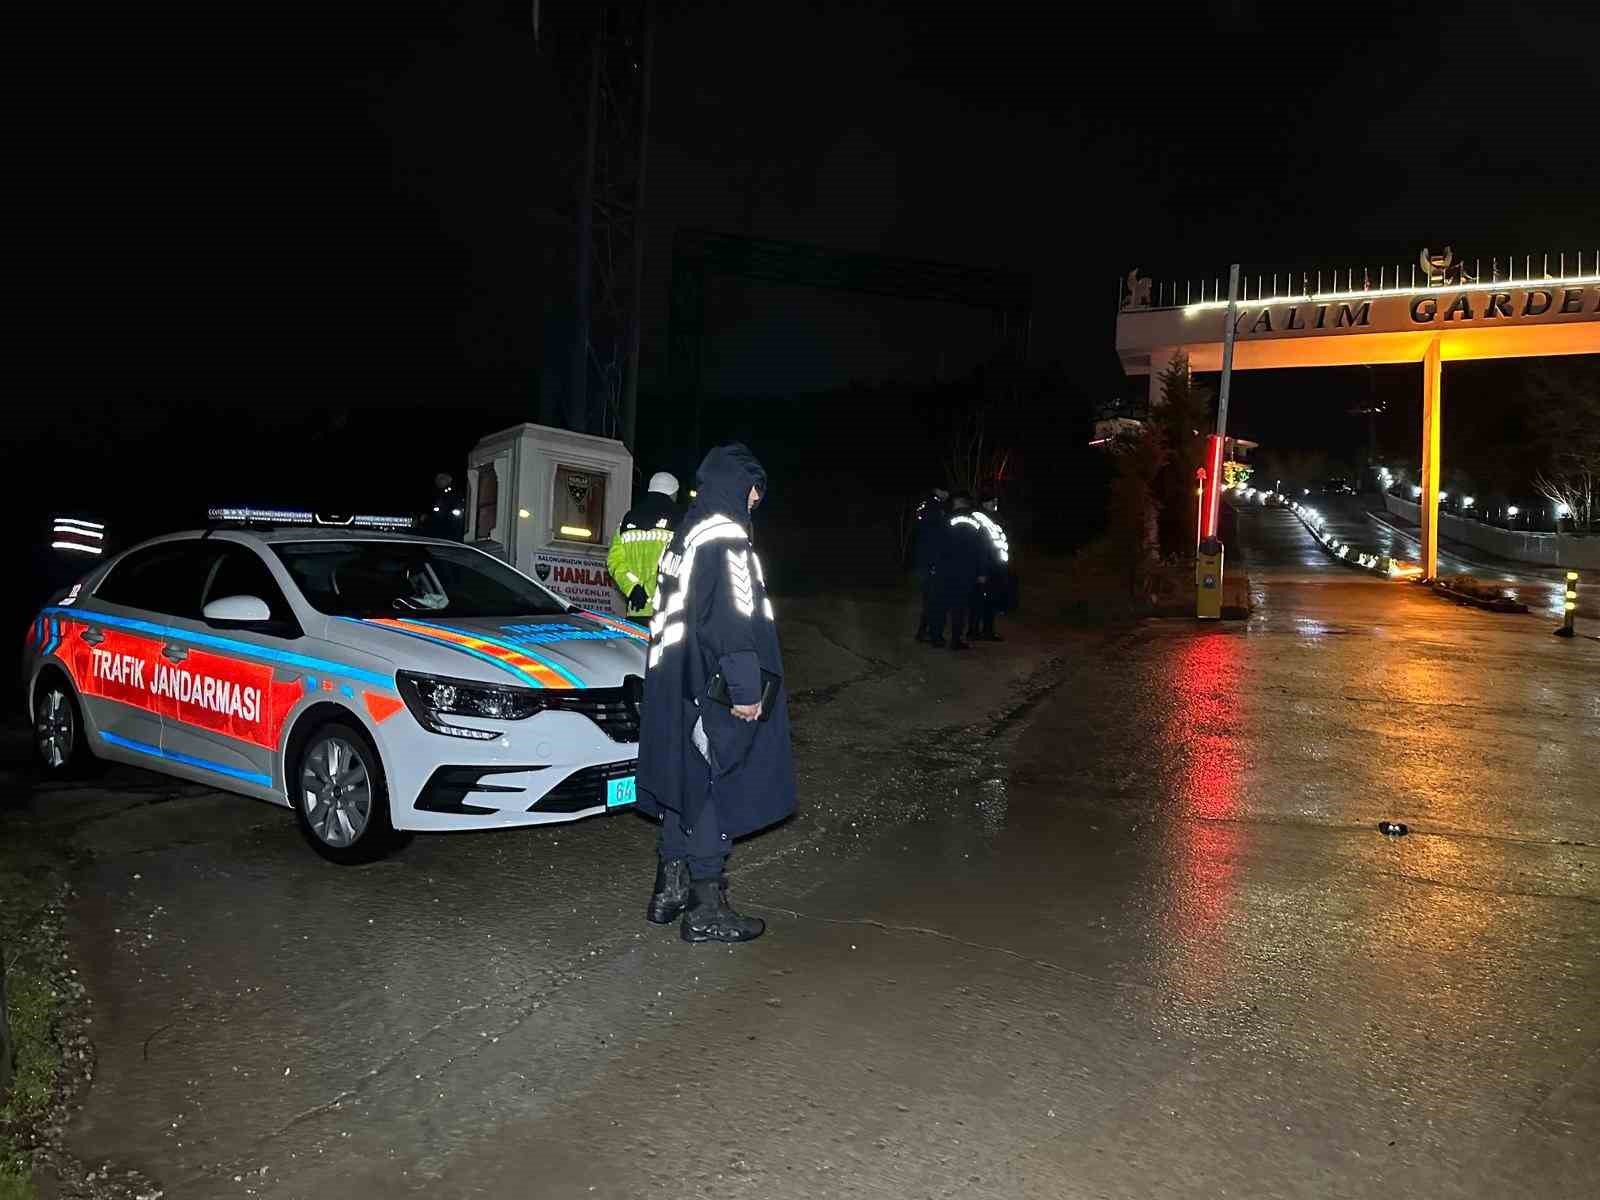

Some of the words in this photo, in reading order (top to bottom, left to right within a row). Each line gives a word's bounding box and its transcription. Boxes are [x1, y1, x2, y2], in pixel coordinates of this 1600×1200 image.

[1410, 286, 1600, 324] GARDE
[92, 648, 145, 689] TRAFİK
[150, 663, 262, 723] JANDARMASI
